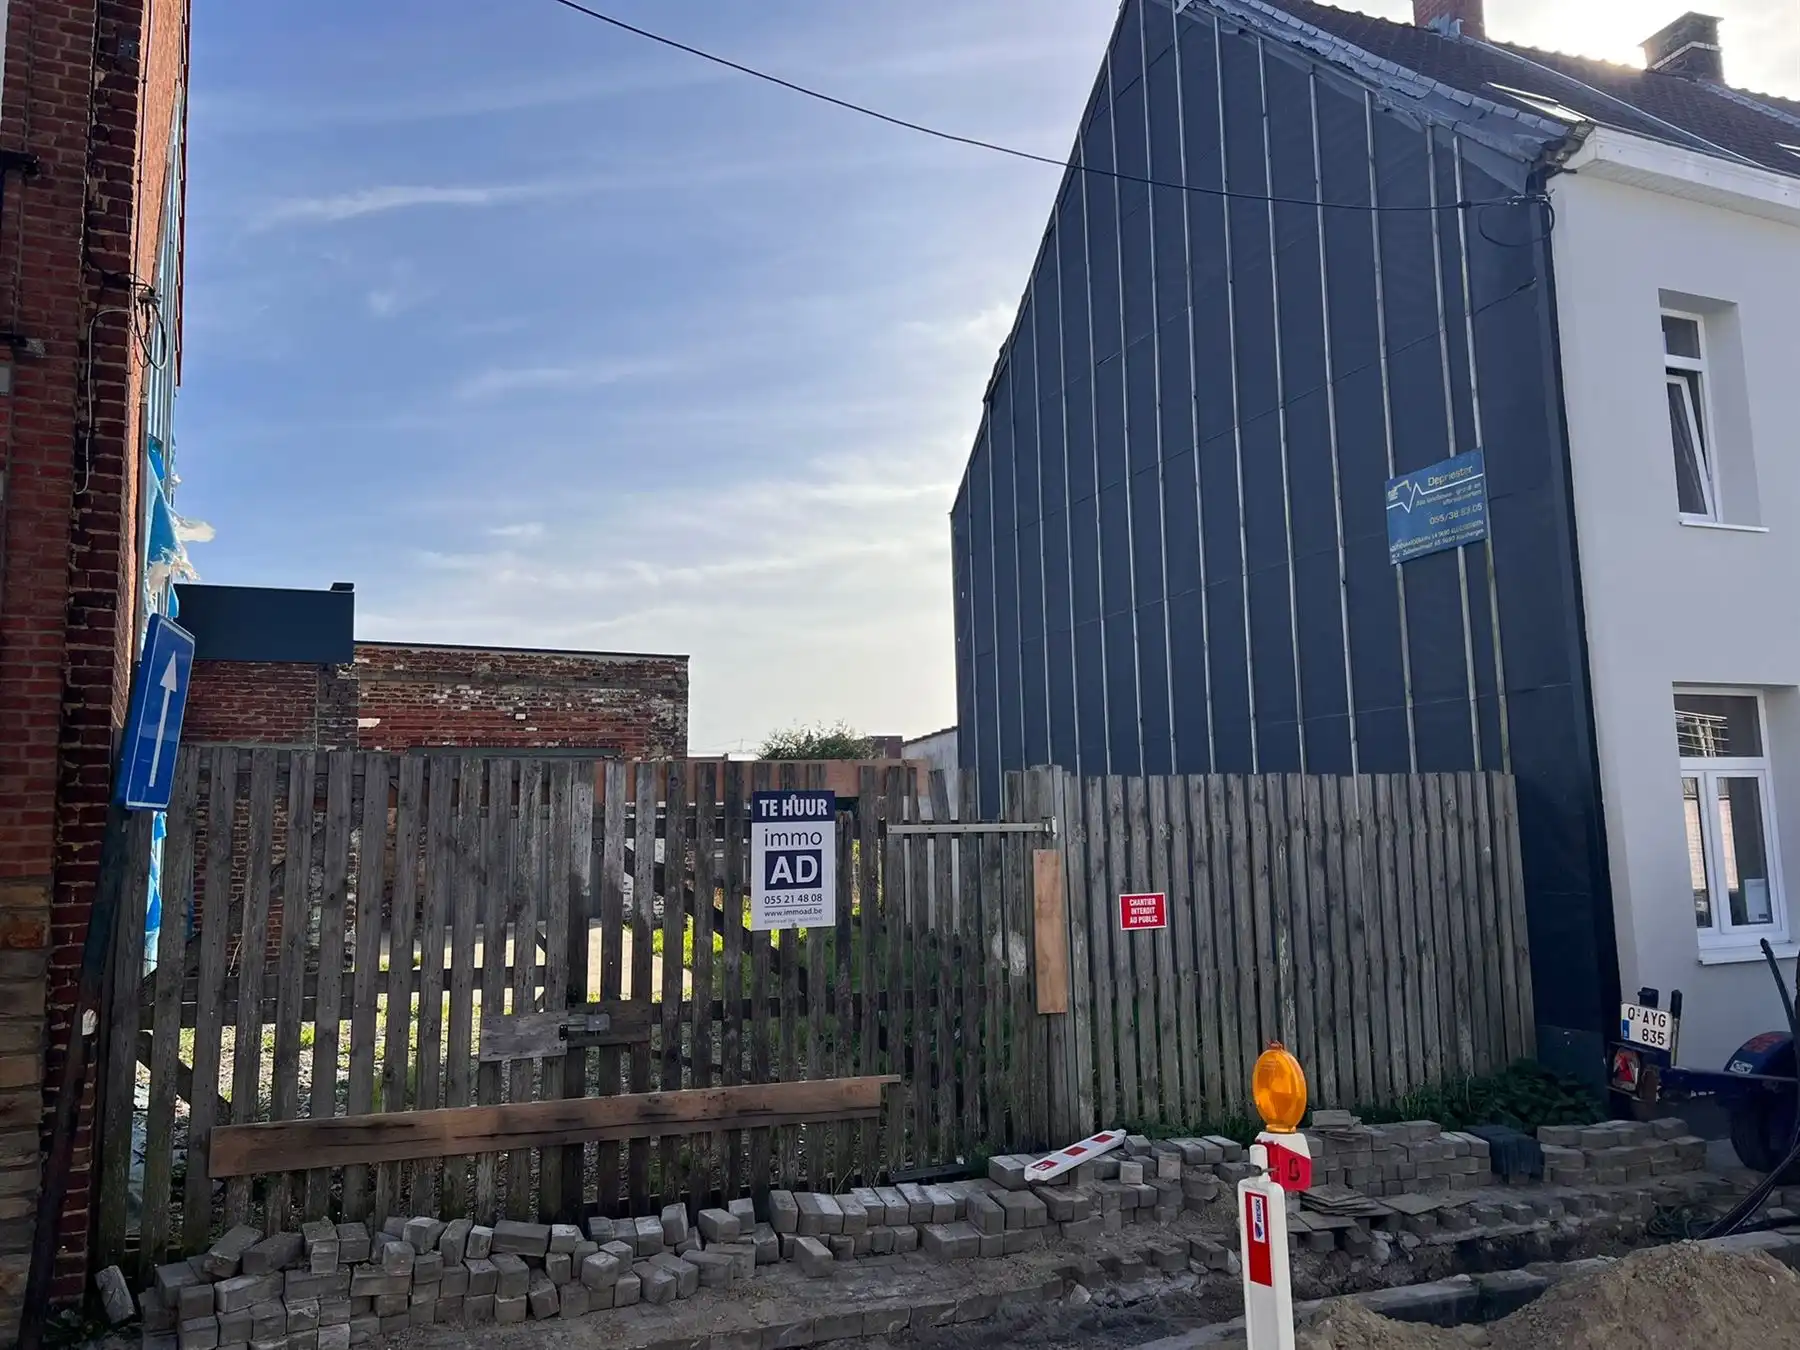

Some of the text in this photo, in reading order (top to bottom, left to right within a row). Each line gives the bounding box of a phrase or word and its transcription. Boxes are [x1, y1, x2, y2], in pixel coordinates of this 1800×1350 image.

[760, 798, 828, 817] TE HUUR
[764, 828, 823, 847] immo
[769, 855, 818, 884] AD
[764, 893, 823, 905] 055 21 48 08
[1129, 898, 1156, 906] CHANTIER
[764, 907, 823, 917] www.immoad.be
[1130, 906, 1155, 915] INTERDIT
[1138, 915, 1158, 923] PUBLIC
[1642, 1028, 1665, 1046] 835
